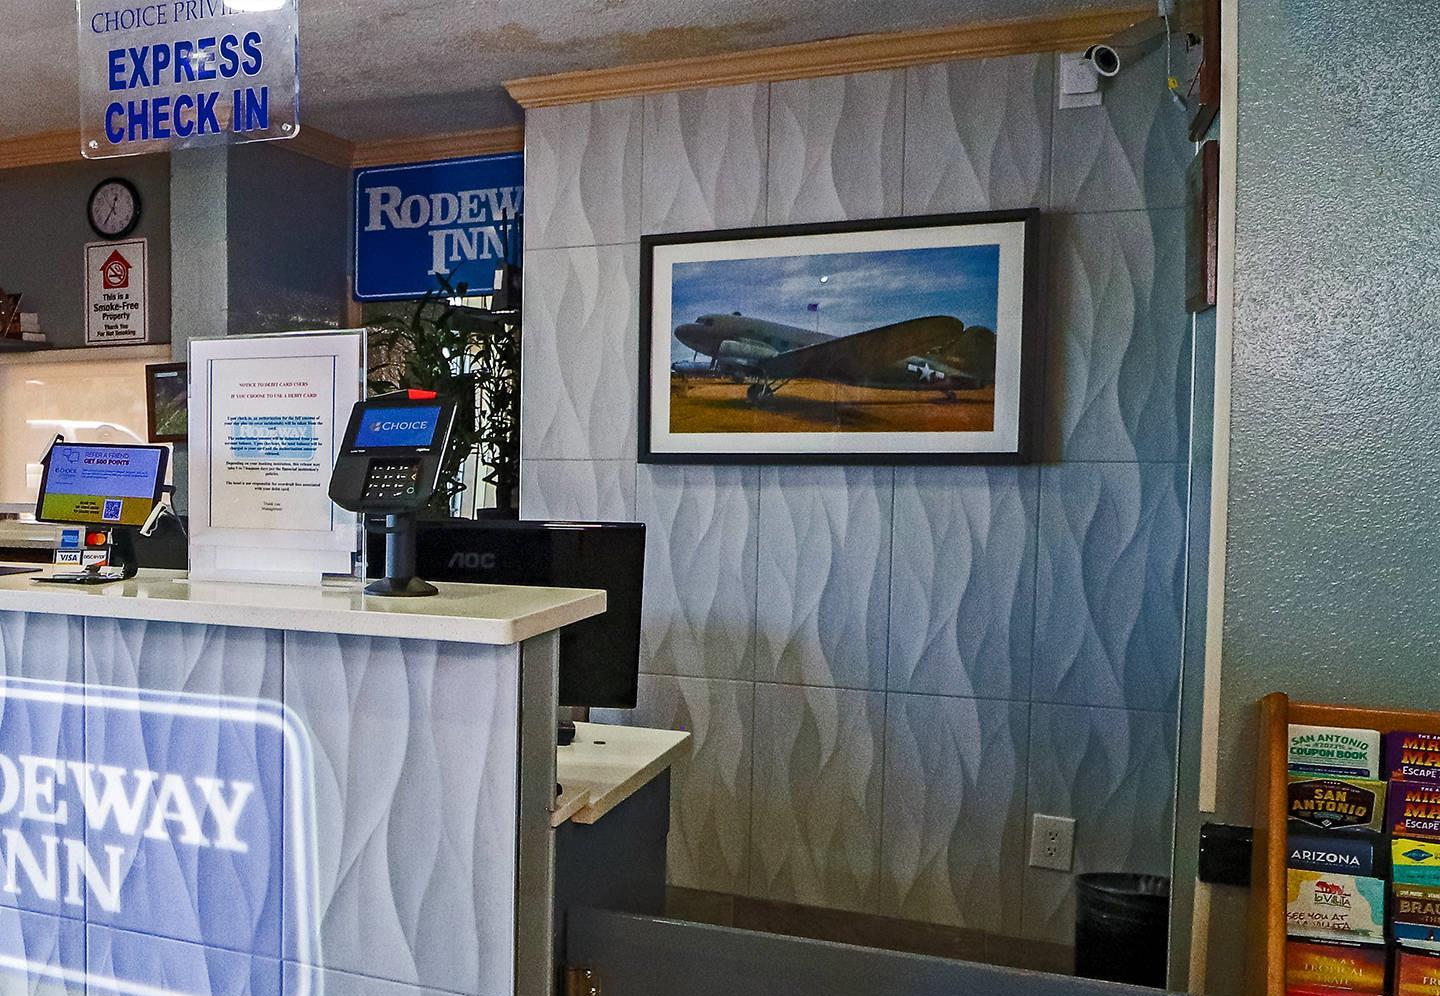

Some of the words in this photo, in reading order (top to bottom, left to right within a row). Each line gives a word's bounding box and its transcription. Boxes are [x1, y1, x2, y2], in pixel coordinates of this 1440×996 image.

[91, 3, 167, 34] CHOICE
[108, 31, 264, 91] EXPRESS
[104, 91, 221, 144] CHECK
[233, 86, 269, 133] IN
[364, 185, 524, 232] RODEW
[427, 225, 512, 276] INN
[93, 302, 139, 312] Smoke-Free
[102, 312, 131, 321] Property
[381, 420, 429, 431] CHOICE
[59, 554, 78, 562] VISA
[447, 552, 497, 569] AOC
[1291, 734, 1316, 746] SAN
[1317, 733, 1369, 751] ANTONIO
[1290, 746, 1335, 758] COUPON
[1337, 749, 1368, 760] BOOK
[1402, 765, 1437, 778] ESCAPE
[1313, 788, 1347, 802] SAN
[1292, 799, 1367, 817] ANTONIO
[1405, 818, 1440, 831] ESCAPE
[1291, 849, 1361, 866] ARIZONA
[1308, 912, 1328, 920] YOU
